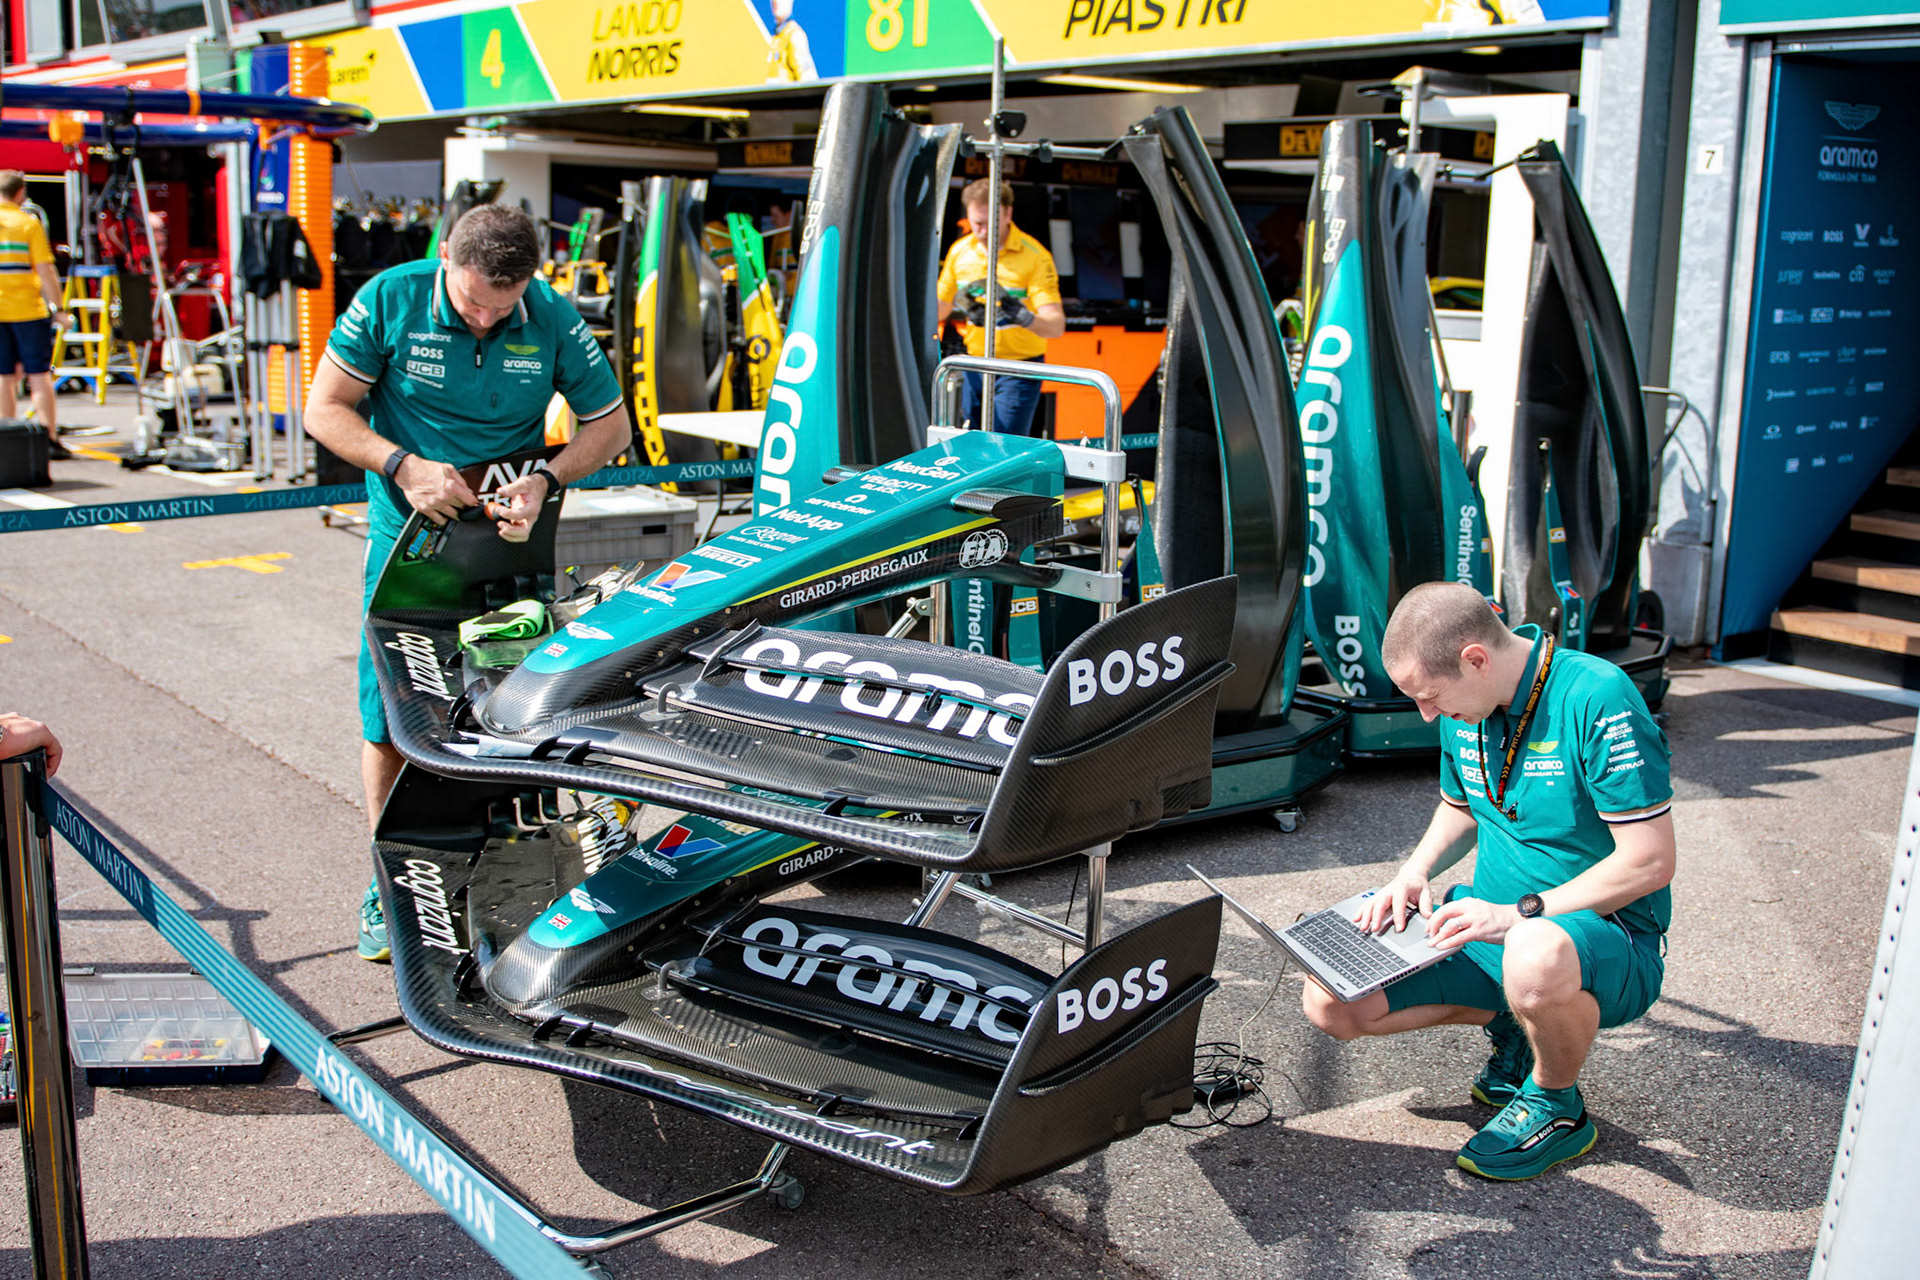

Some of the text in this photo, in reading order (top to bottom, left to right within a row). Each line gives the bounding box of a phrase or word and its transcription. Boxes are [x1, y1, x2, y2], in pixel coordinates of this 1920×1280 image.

[592, 0, 683, 42] LANDO
[866, 0, 929, 52] 81
[480, 28, 506, 89] 4
[587, 42, 683, 83] NORRIS
[1704, 149, 1716, 169] 7
[1820, 145, 1878, 168] aramco
[800, 200, 826, 255] EPOS
[1322, 218, 1347, 264] EPOS
[407, 331, 452, 343] cognizant
[410, 345, 444, 360] BOSS
[408, 361, 444, 377] JCB
[503, 359, 542, 370] aramco
[759, 331, 818, 517] aram
[679, 463, 724, 480] ASTON
[885, 460, 961, 481] NexGen
[1299, 324, 1352, 587] aramco
[859, 483, 901, 495] BLACK
[860, 473, 933, 492] VELOCITY
[63, 498, 216, 526] ASTON MARTIN
[770, 508, 844, 531] NetApp
[804, 497, 876, 515] servicenow
[692, 545, 762, 569] PIRELLI
[1457, 504, 1477, 588] Sentinel
[779, 548, 929, 609] GIRARD-PERREGAUX
[1010, 599, 1037, 615] JCB
[384, 632, 458, 702] cognizant
[1067, 635, 1186, 707] BOSS
[1334, 615, 1367, 698] BOSS
[742, 638, 1039, 746] aramc
[1459, 746, 1488, 764] BOSS
[1524, 759, 1564, 771] aramco
[56, 800, 145, 907] ASTON MARTIN
[627, 847, 679, 877] Valvoline
[394, 858, 470, 956] cognizant
[742, 917, 1037, 1043] aramc
[1056, 958, 1169, 1034] BOSS
[315, 1046, 497, 1243] ASTON MARTIN
[1538, 1124, 1555, 1140] BOSS
